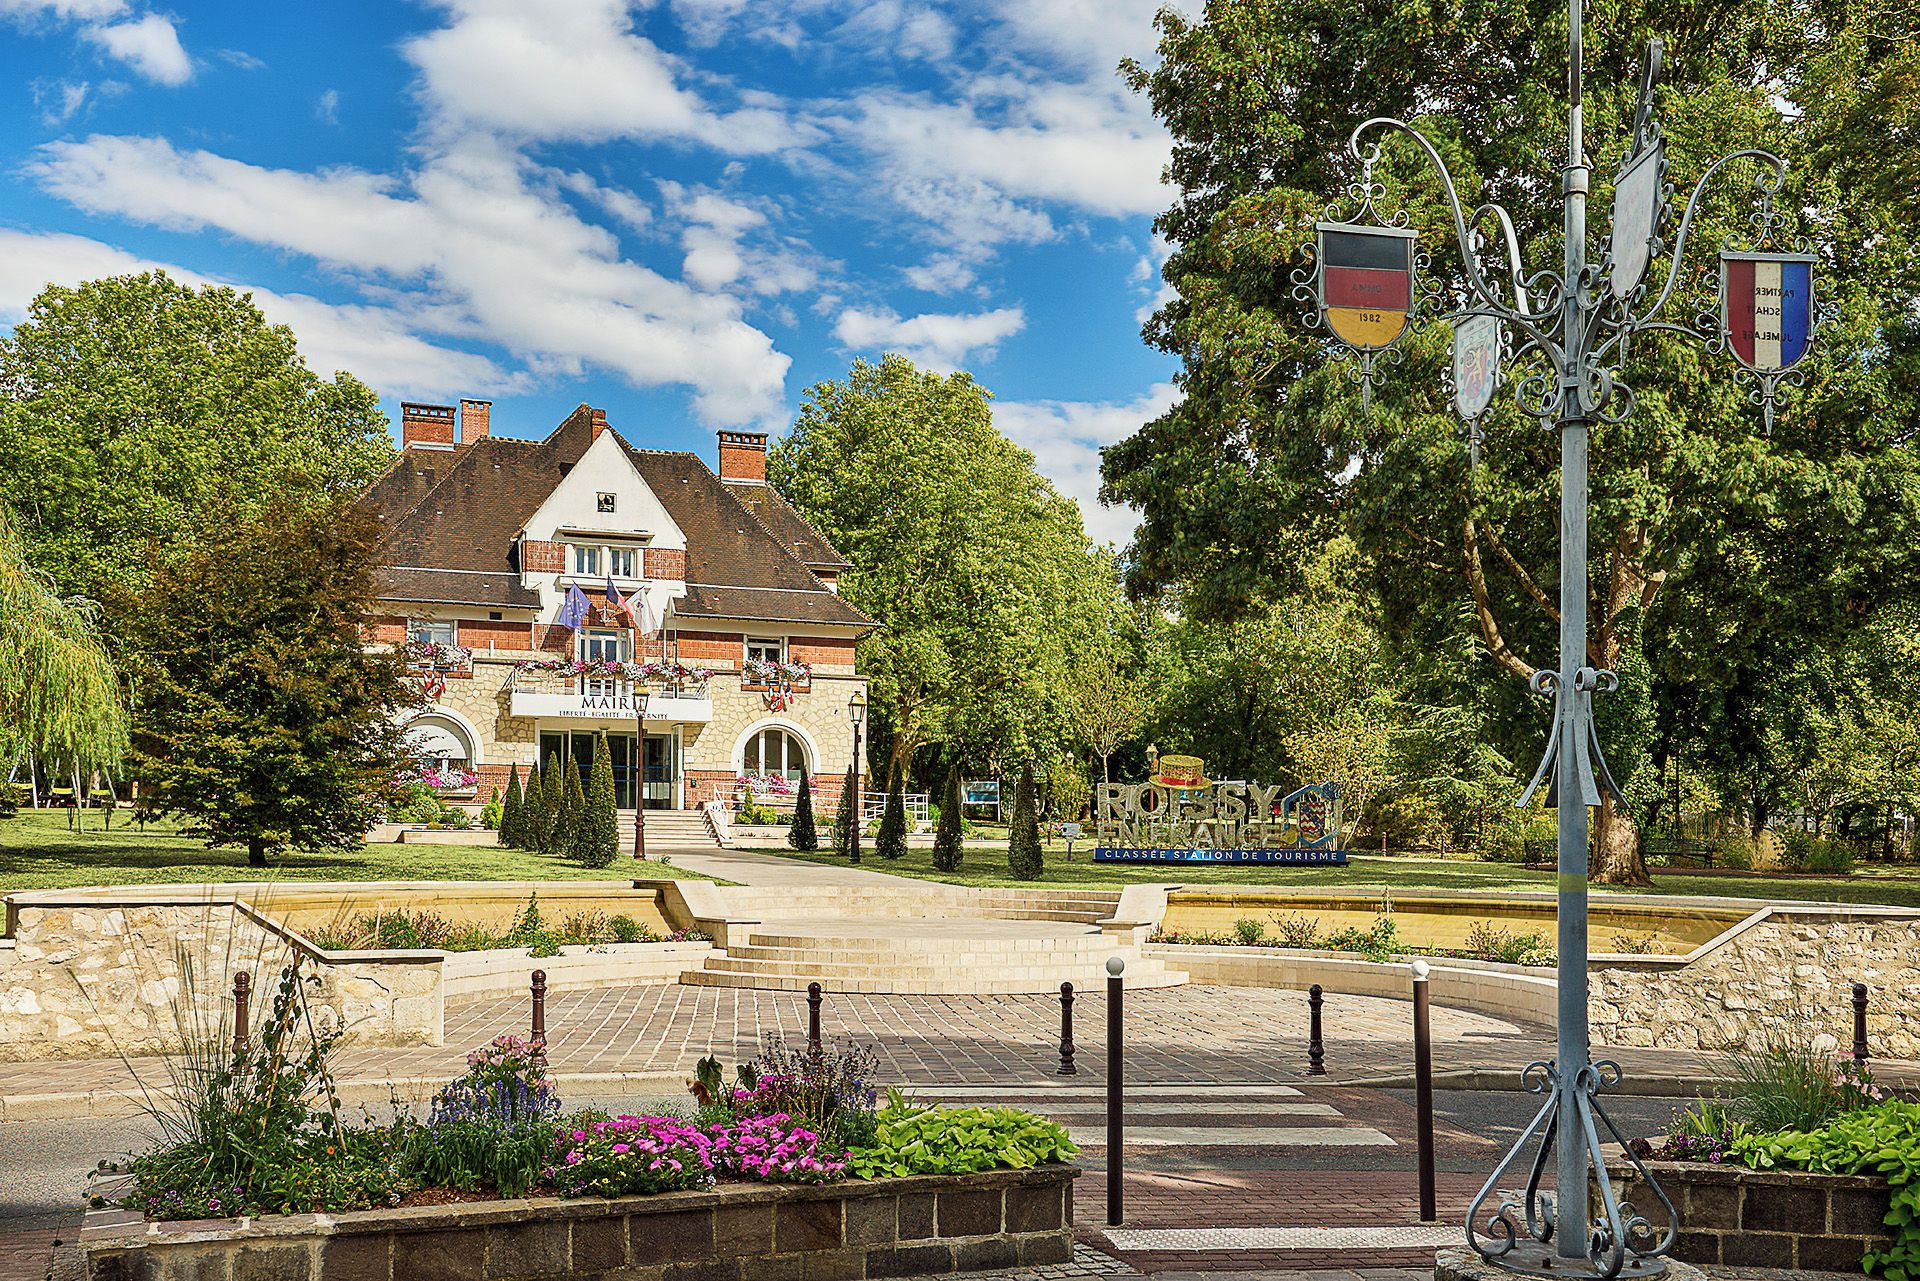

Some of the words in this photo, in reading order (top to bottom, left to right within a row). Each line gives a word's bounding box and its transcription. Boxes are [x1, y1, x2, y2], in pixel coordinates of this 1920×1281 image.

[1359, 313, 1381, 322] 1982
[626, 712, 668, 720] FRRNITÉ
[1097, 782, 1281, 821] ROISSY
[1097, 822, 1140, 849] EN
[1151, 822, 1281, 850] FRANCE
[1105, 848, 1166, 860] CLASSÉE
[1174, 850, 1233, 860] STATION
[1241, 851, 1257, 860] DE
[1266, 851, 1338, 861] TOURISME
